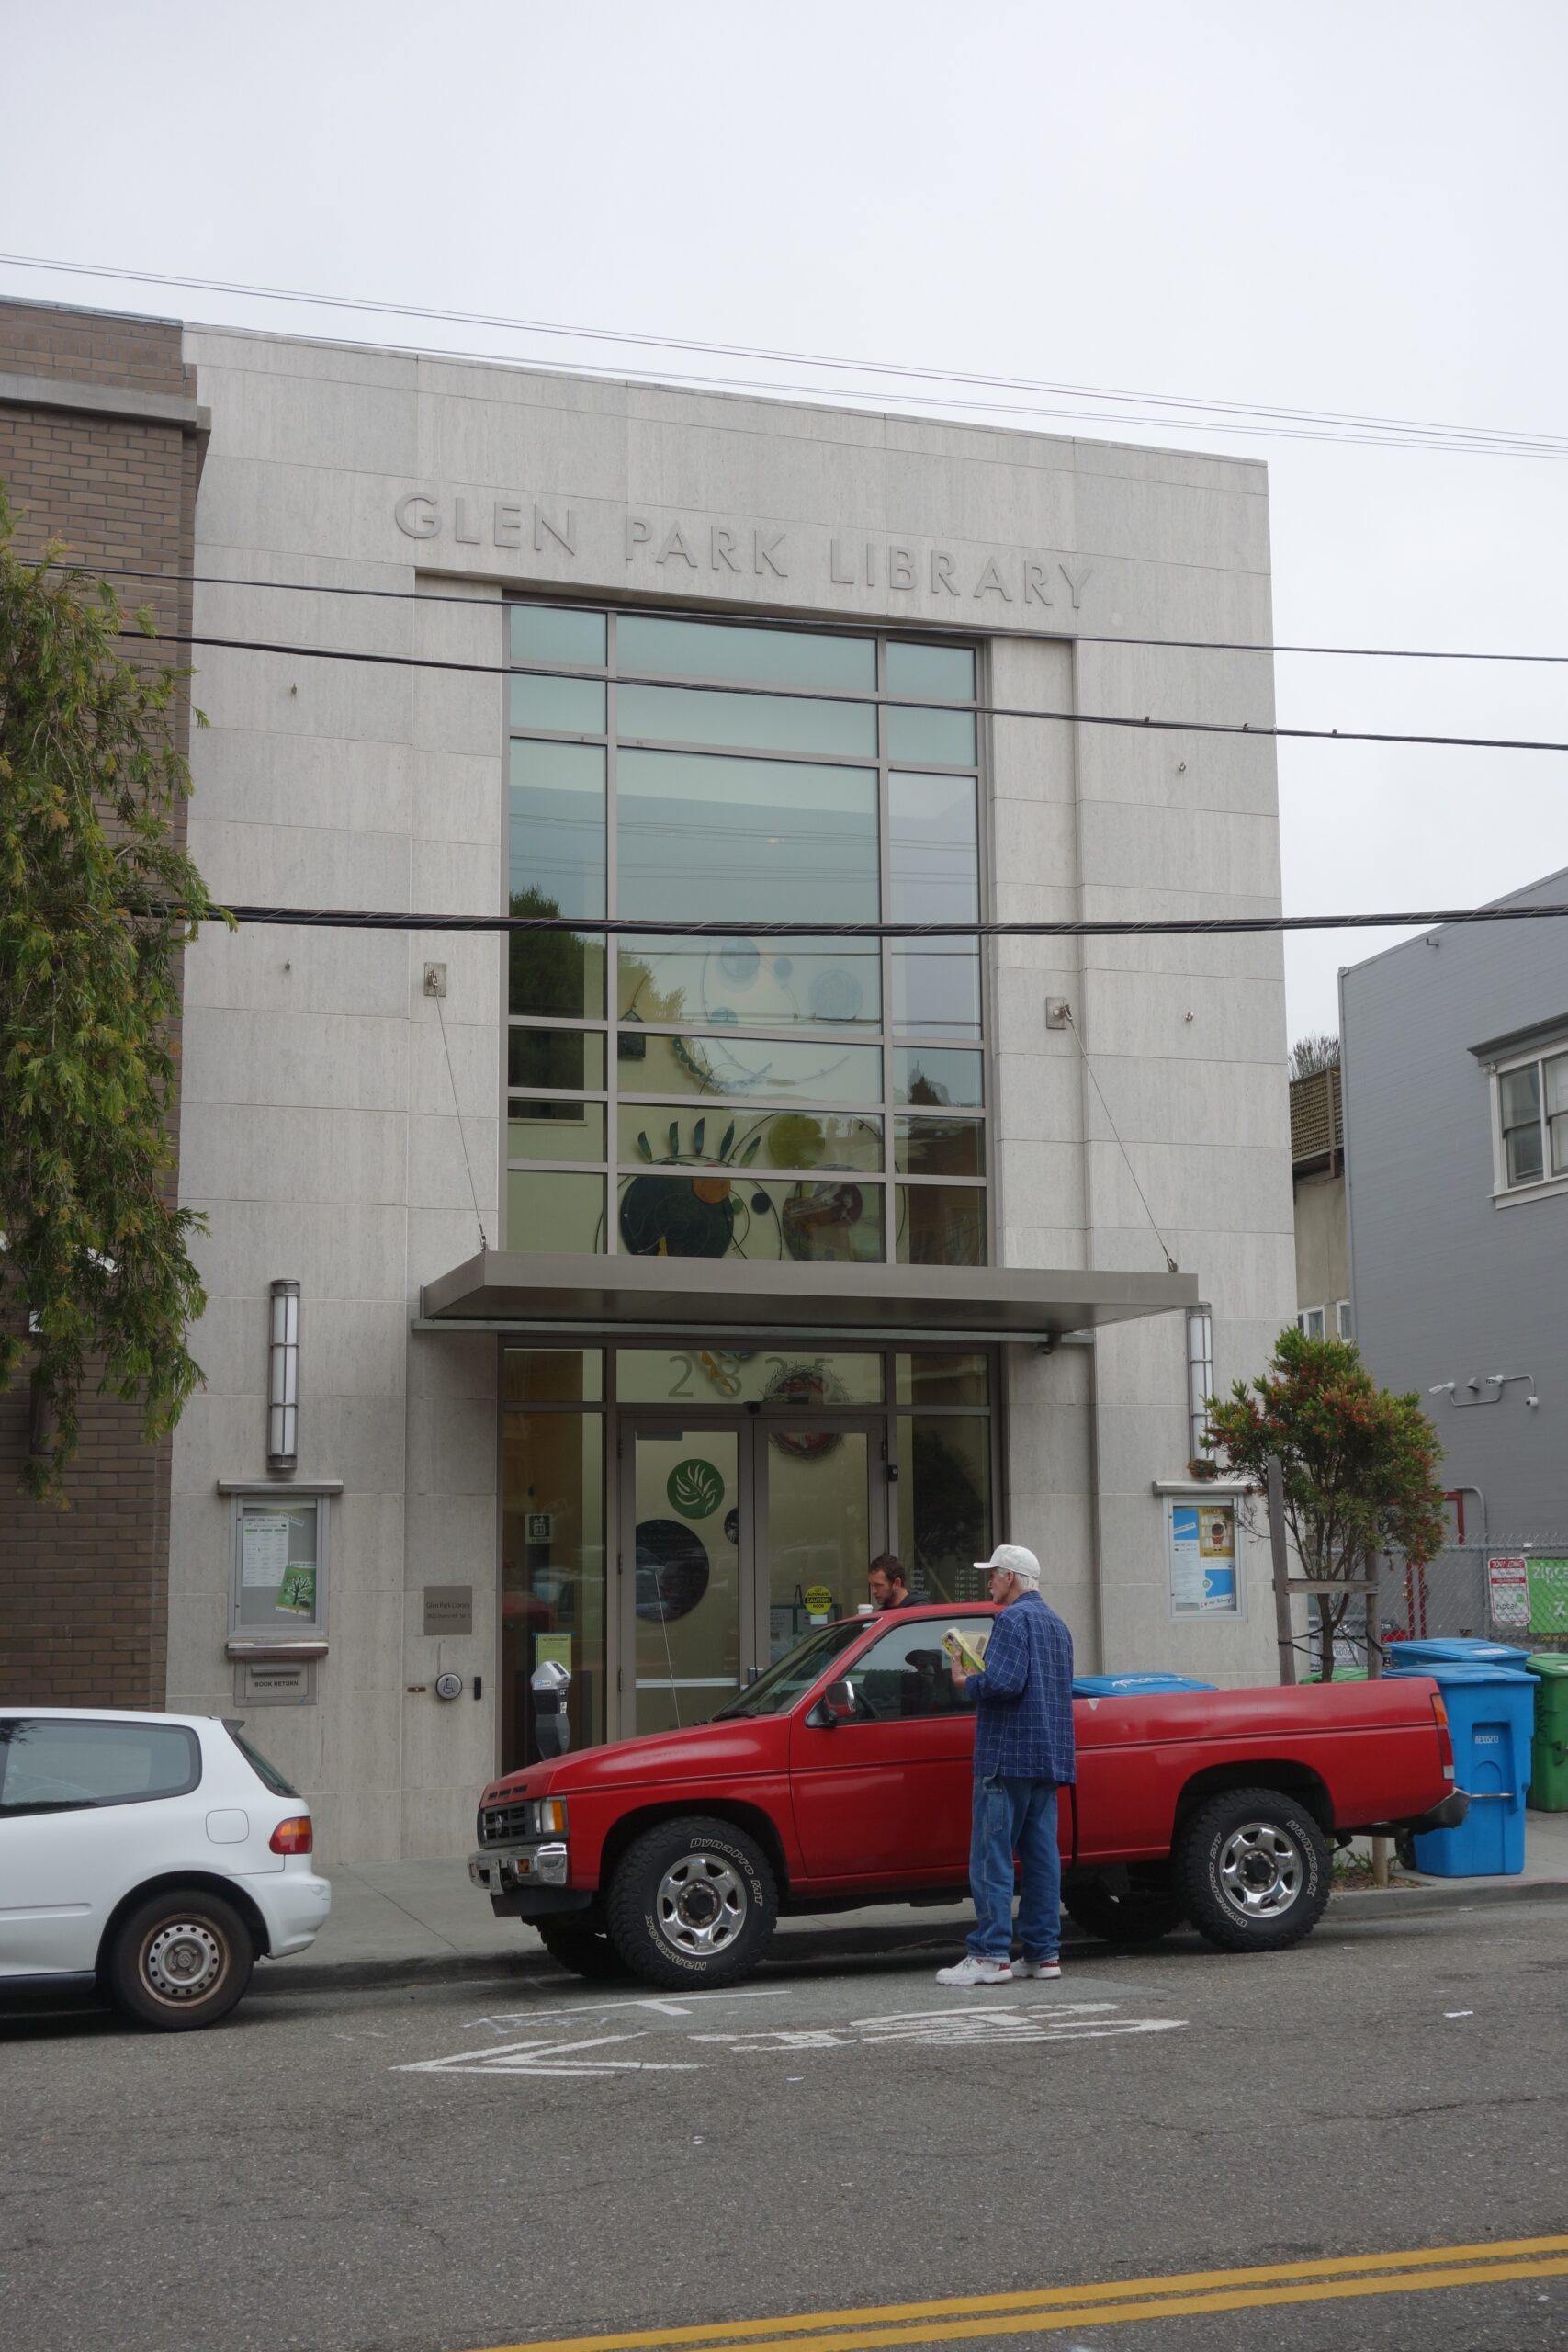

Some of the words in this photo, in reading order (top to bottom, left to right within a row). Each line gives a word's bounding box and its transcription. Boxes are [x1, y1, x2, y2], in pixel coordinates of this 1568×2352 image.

[393, 491, 577, 557] GLEN
[625, 514, 790, 579] PARK
[829, 537, 1094, 610] LIBRARY
[668, 1354, 834, 1398] 282
[1209, 1831, 1224, 1860] MT
[750, 1879, 764, 1908] MT
